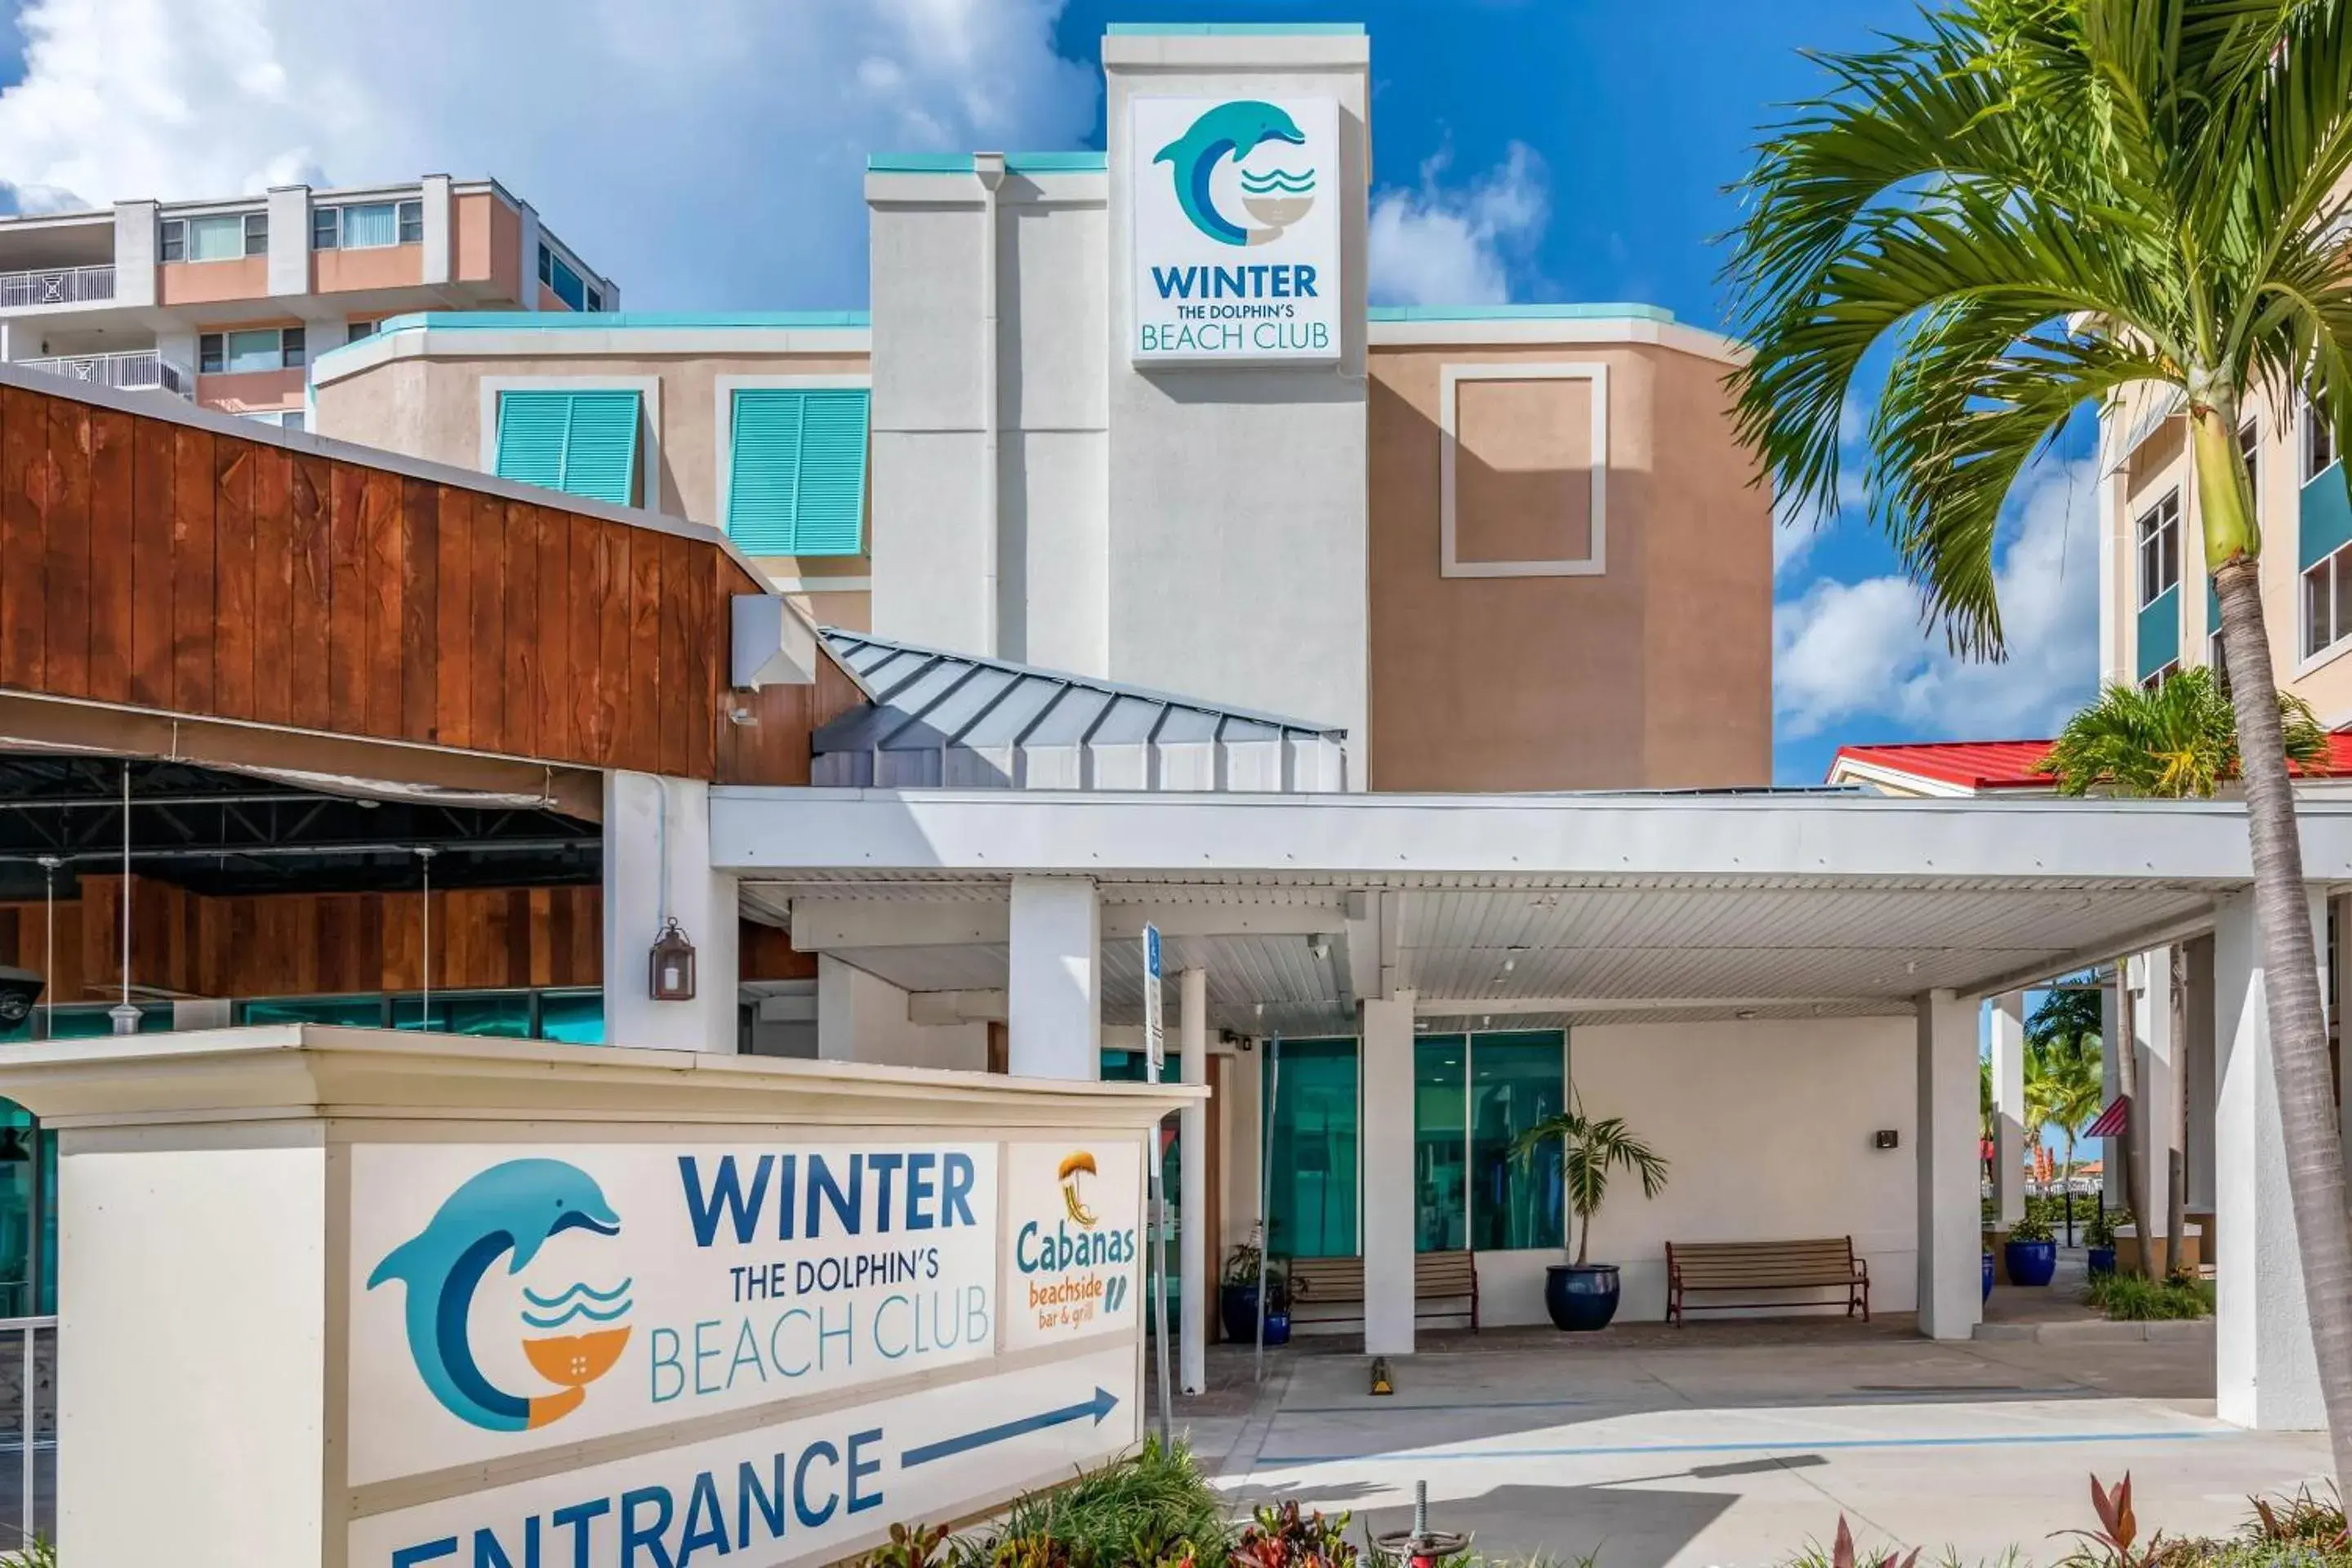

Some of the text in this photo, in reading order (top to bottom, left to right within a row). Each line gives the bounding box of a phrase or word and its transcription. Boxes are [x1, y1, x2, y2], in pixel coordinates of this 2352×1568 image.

[1152, 265, 1318, 299] WINTER
[1177, 303, 1294, 320] THE DOLPHIN'S
[1142, 323, 1329, 350] BEACH CLUB
[678, 1153, 976, 1247] WINTER
[1017, 1218, 1134, 1274] Cabanas
[729, 1248, 938, 1302] THE DOLPHIN'S
[1029, 1272, 1102, 1307] beachside
[1039, 1308, 1057, 1330] bar
[1061, 1305, 1069, 1324] &
[652, 1285, 988, 1403] BEACH CLUB
[391, 1428, 883, 1568] TRANCE
